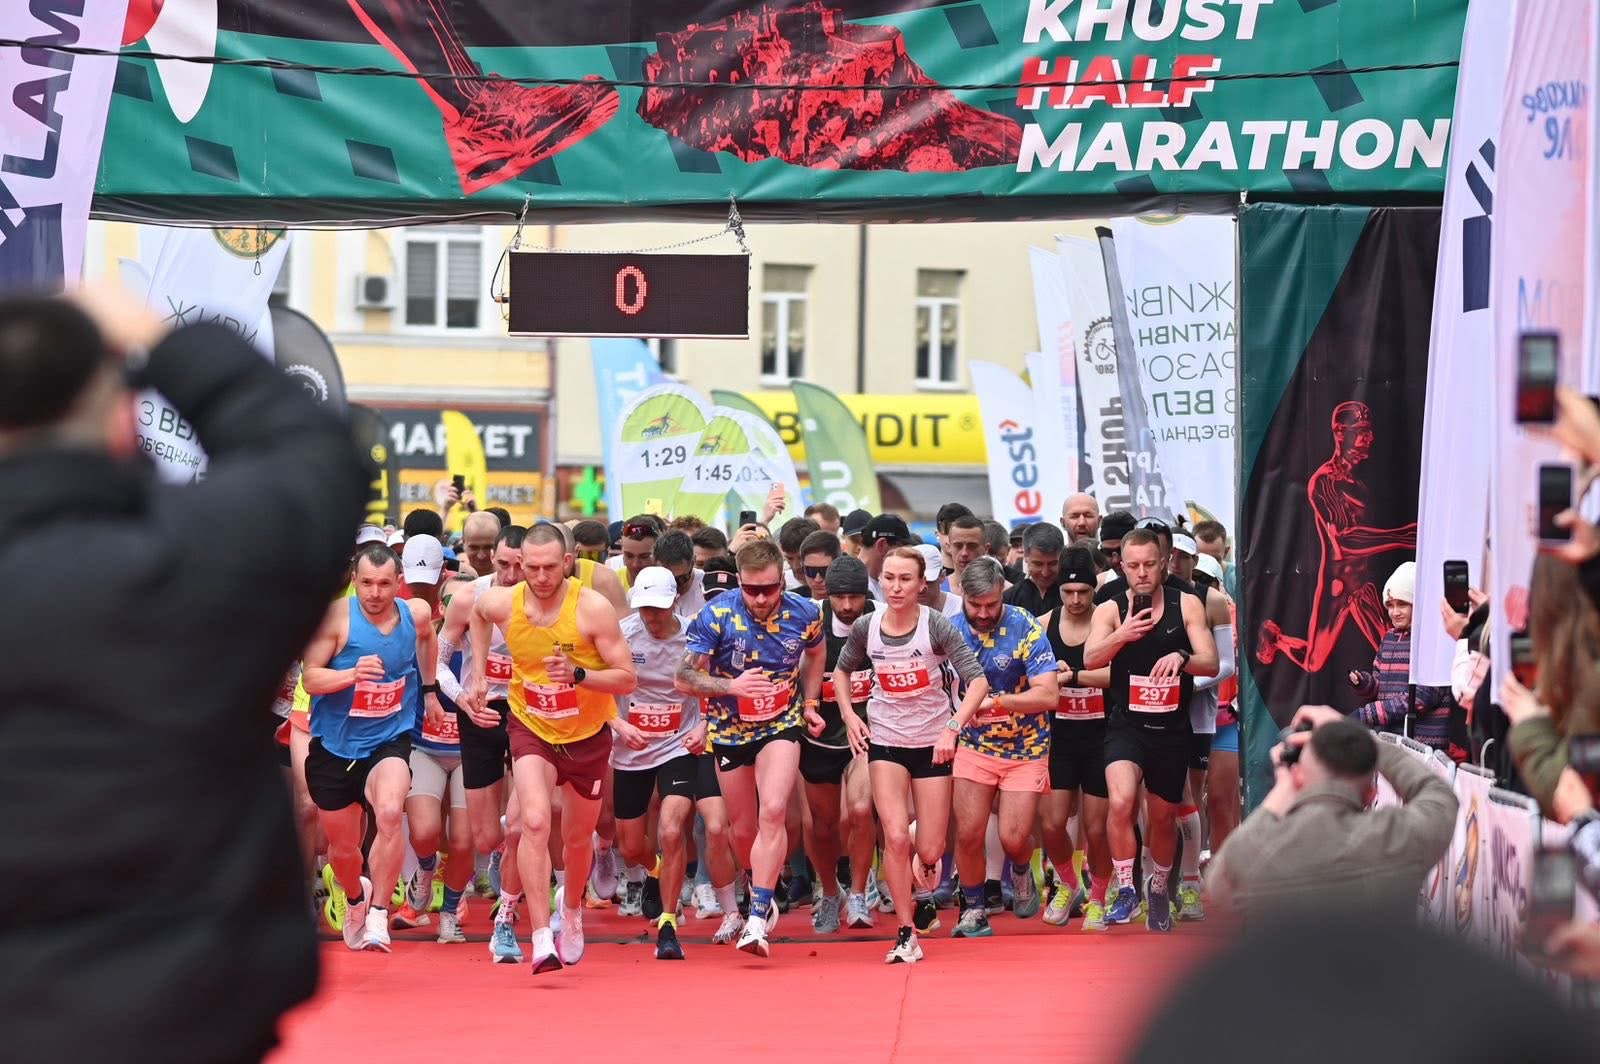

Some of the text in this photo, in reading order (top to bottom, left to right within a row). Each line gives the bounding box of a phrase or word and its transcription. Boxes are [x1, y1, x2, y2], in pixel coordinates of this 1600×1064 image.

[1022, 0, 1274, 43] KHUST
[1015, 54, 1222, 110] HALF
[1016, 118, 1451, 173] MARATHON
[616, 265, 647, 315] 0
[775, 412, 949, 448] BDIT
[389, 423, 532, 457] AET
[641, 445, 687, 469] 1:29
[695, 464, 733, 481] 1:45
[851, 681, 864, 694] 2
[886, 673, 918, 688] 338
[363, 691, 396, 707] 149
[536, 694, 558, 707] 31
[1138, 687, 1170, 701] 297
[753, 696, 776, 710] 92
[1069, 698, 1087, 710] 11
[639, 714, 671, 727] 335
